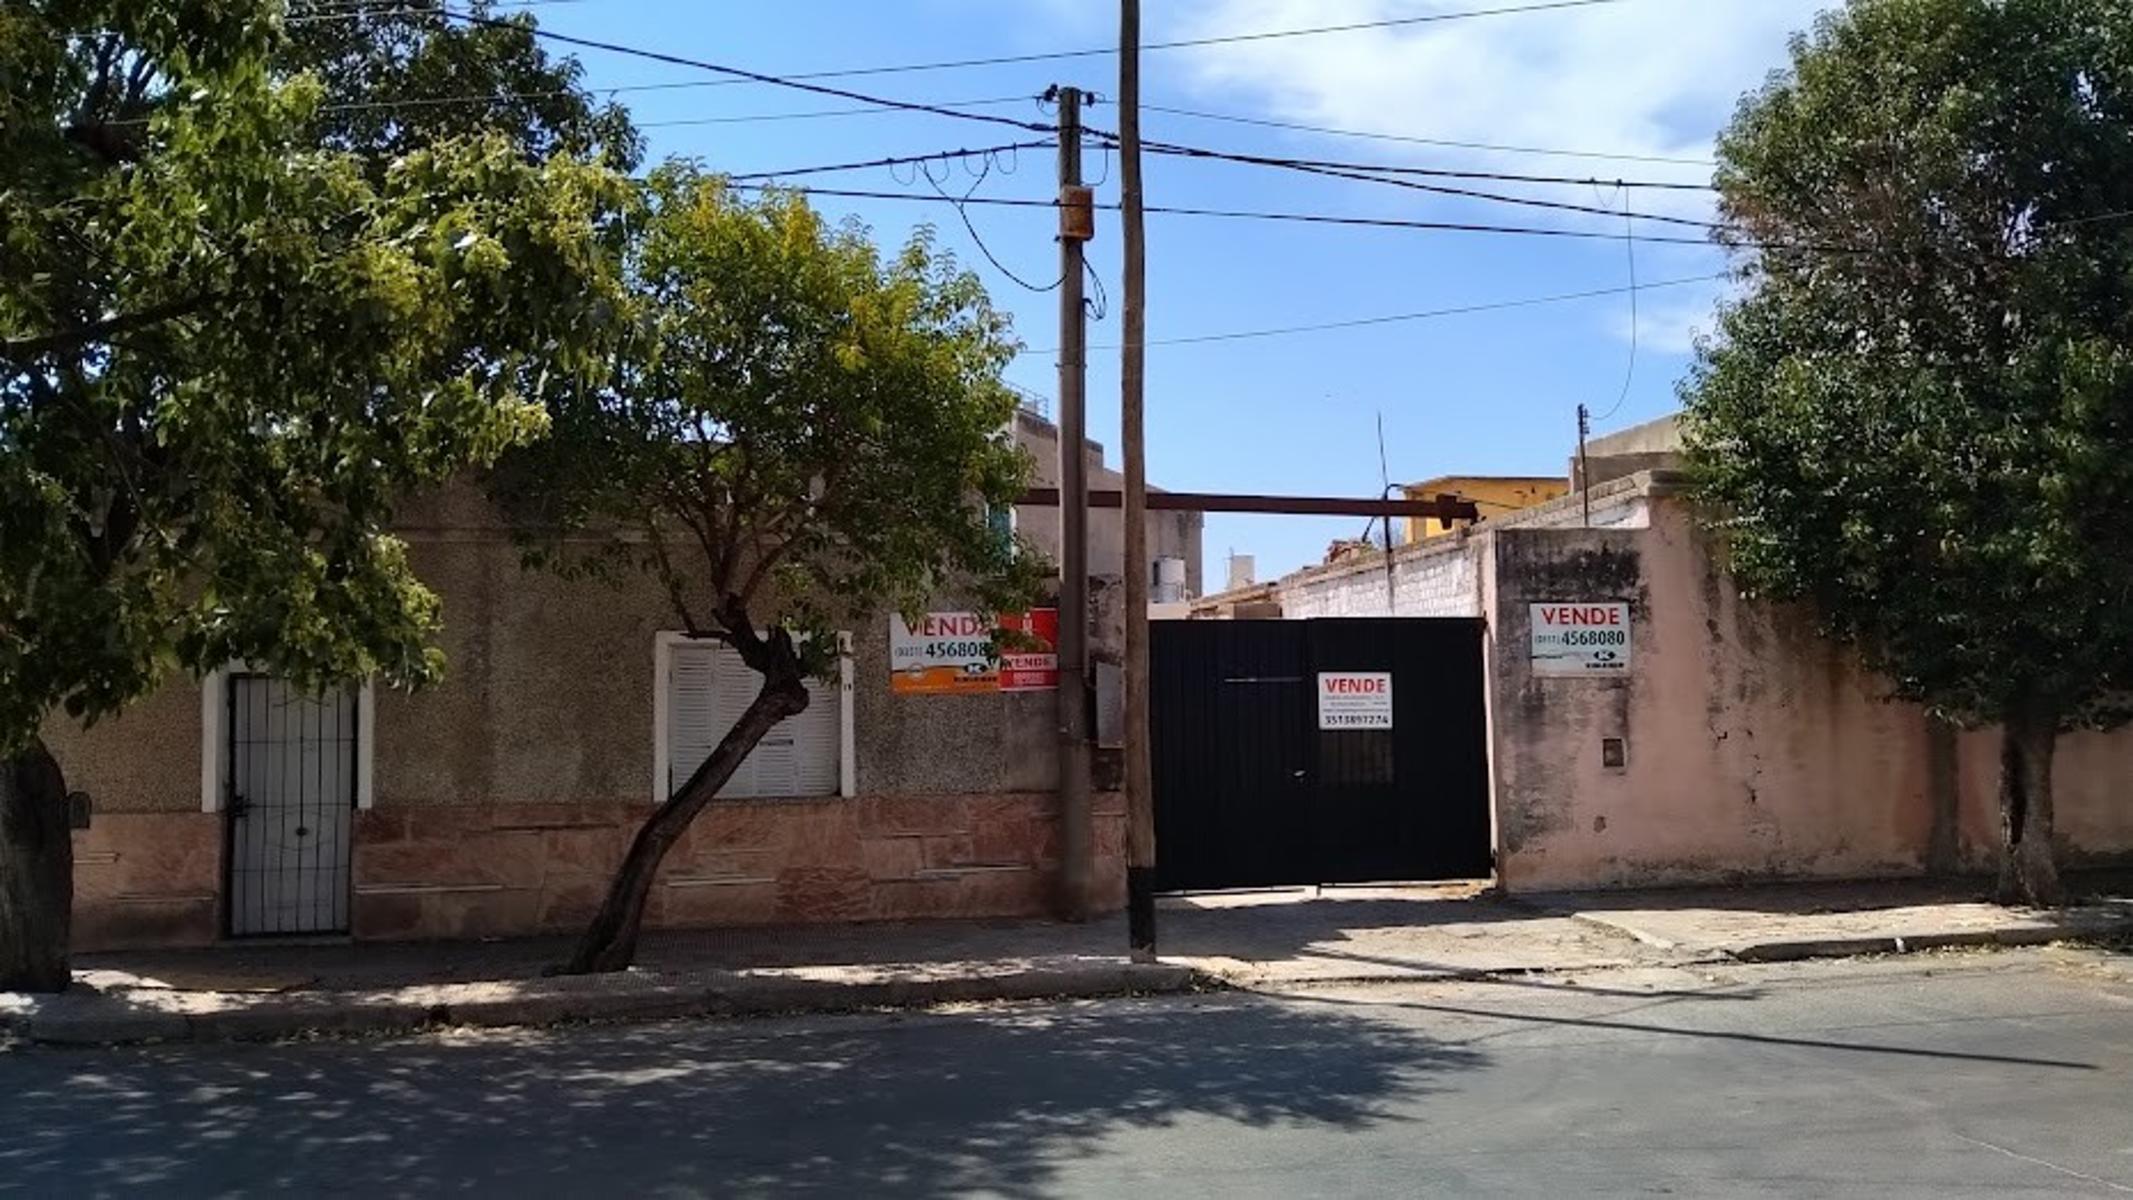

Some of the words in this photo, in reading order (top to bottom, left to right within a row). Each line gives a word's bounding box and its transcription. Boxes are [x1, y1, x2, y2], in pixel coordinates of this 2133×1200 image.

[1540, 607, 1620, 625] VENDE
[905, 616, 992, 636] VEND
[1562, 630, 1625, 646] 4568080
[925, 641, 996, 658] 456808
[1325, 678, 1386, 693] VENDE
